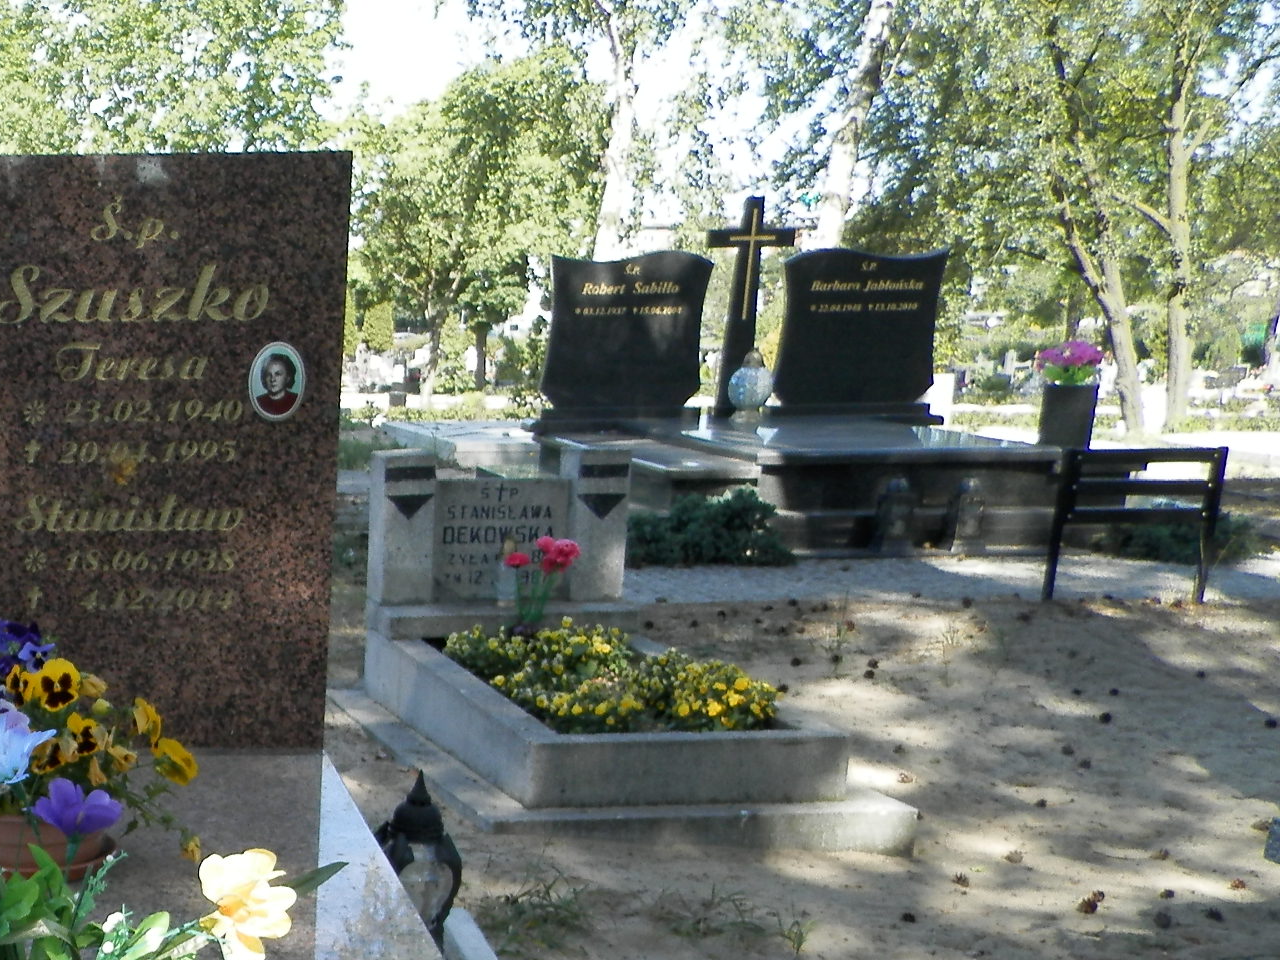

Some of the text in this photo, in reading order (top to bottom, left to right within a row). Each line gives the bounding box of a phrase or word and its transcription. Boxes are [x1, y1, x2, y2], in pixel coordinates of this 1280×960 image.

[582, 282, 625, 296] Robert
[810, 280, 860, 292] Barbara
[55, 341, 210, 382] Teresa
[64, 400, 243, 423] 23.02.1940
[447, 505, 553, 520] STANISŁAWA
[443, 525, 554, 544] DEKOWSKA
